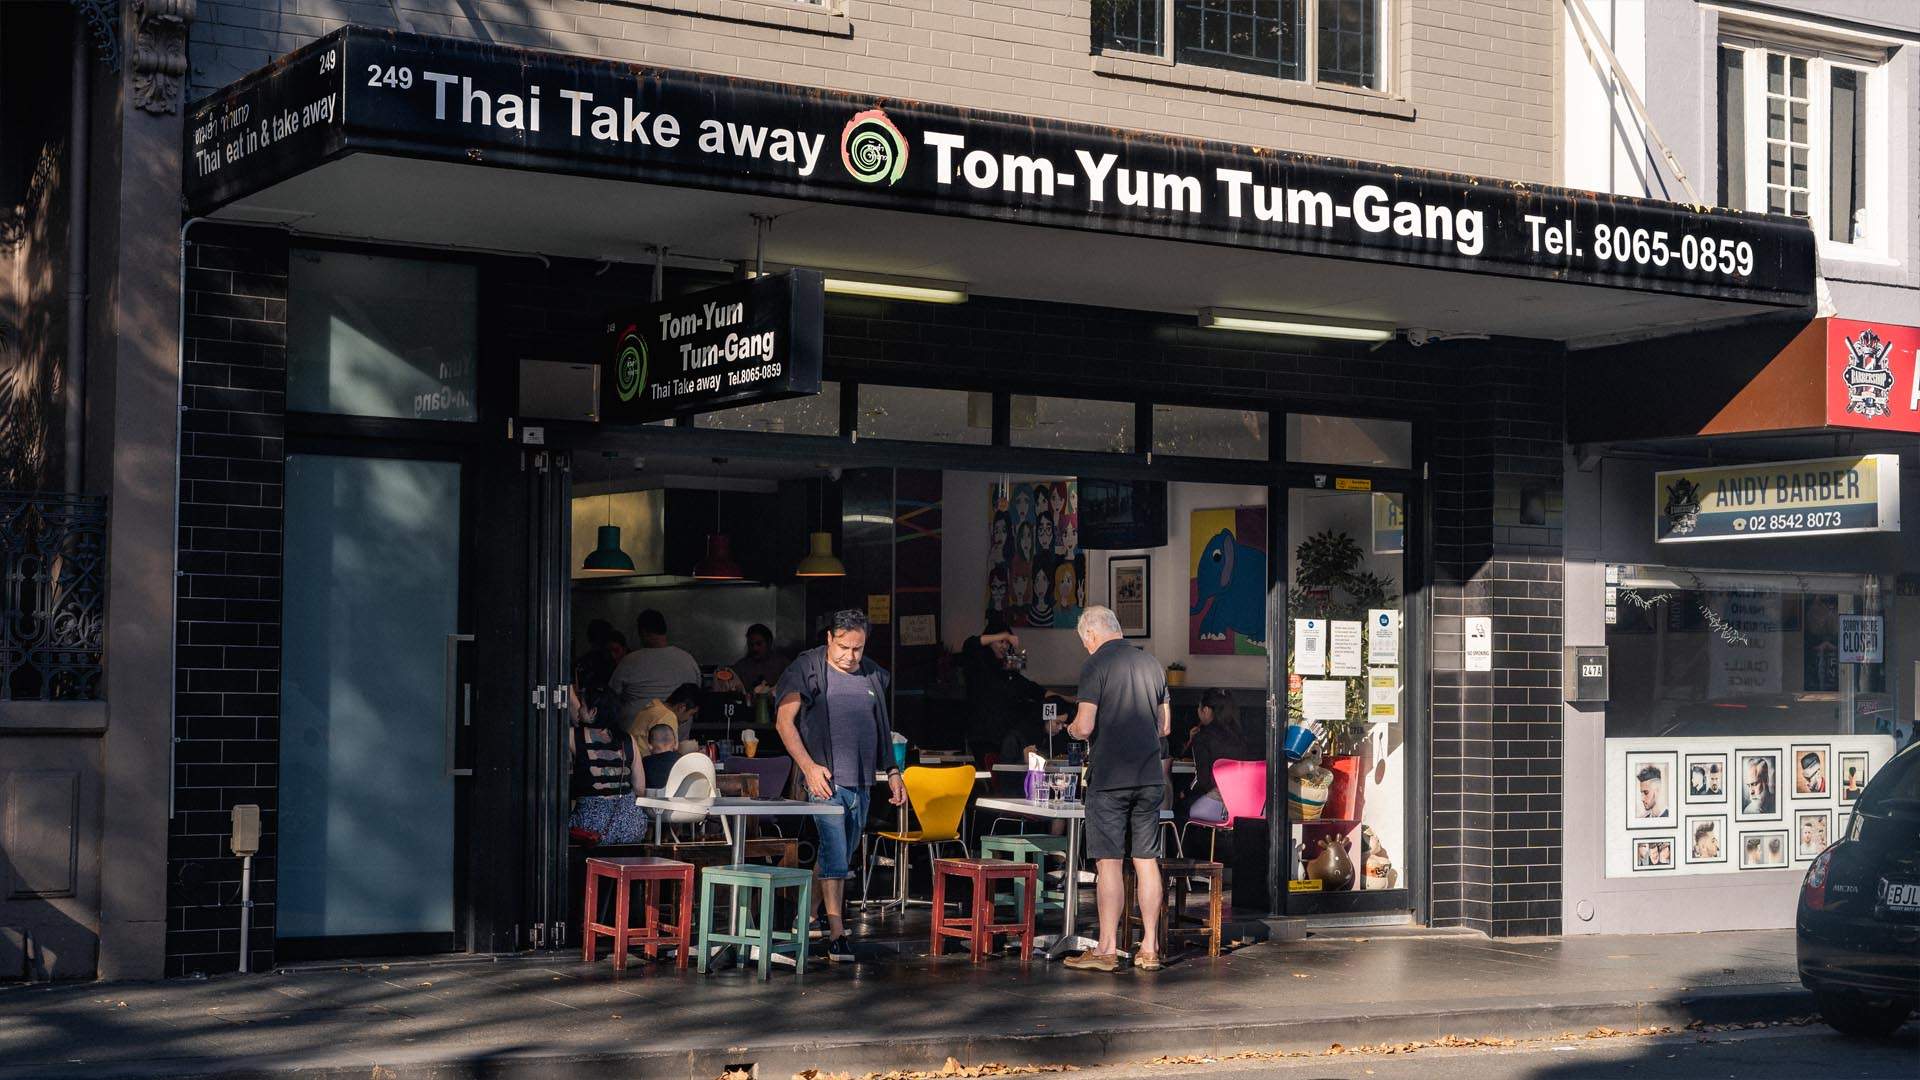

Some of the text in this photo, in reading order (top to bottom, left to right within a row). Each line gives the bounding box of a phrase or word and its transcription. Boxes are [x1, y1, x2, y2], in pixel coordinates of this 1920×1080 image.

[319, 49, 336, 75] 249
[367, 64, 413, 89] 249
[195, 92, 337, 177] Thai eat in & take away
[423, 71, 826, 177] Thai Take away
[923, 130, 1484, 256] Tom-Yum Tum-Gang
[1524, 214, 1754, 277] Tel. 8065-0859
[659, 301, 744, 341] Tom-Yum
[679, 330, 775, 372] Tum-Gang
[650, 383, 671, 400] Thai
[672, 378, 695, 396] Take
[696, 373, 722, 393] away
[1716, 469, 1860, 508] ANDY BARBER
[1749, 511, 1842, 531] 02 8542 8073
[1583, 665, 1602, 676] 247A
[724, 703, 735, 716] 18
[1045, 705, 1055, 716] 64
